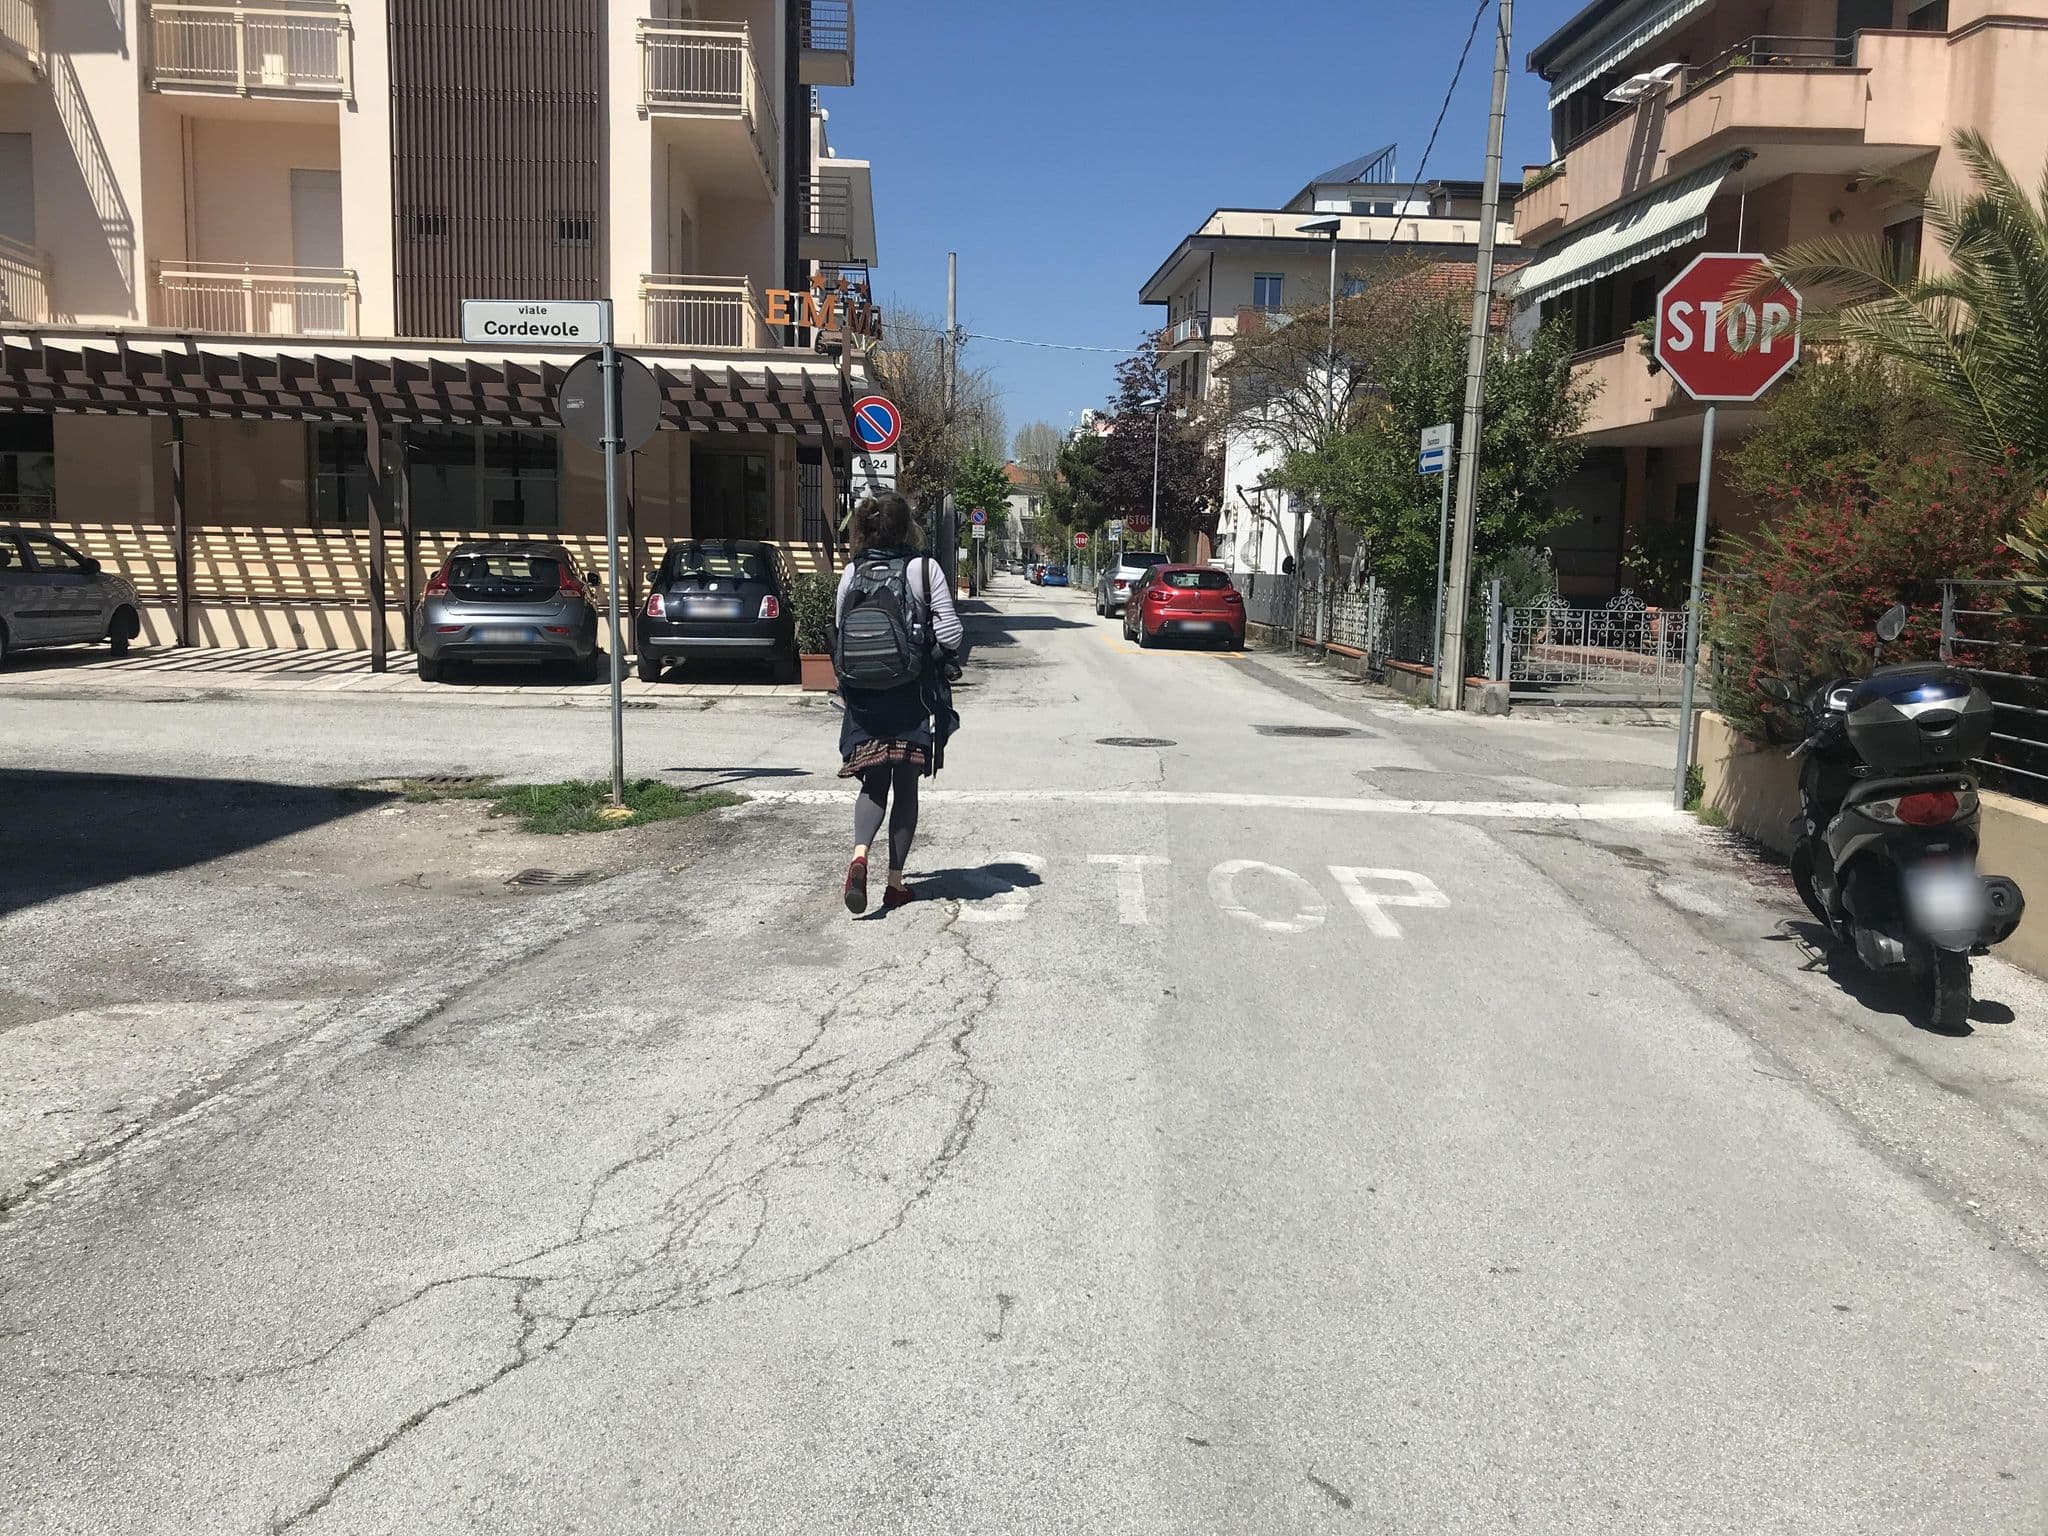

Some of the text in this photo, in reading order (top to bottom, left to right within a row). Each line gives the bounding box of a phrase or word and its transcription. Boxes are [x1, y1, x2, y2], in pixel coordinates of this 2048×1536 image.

[518, 305, 548, 315] viale
[484, 320, 579, 336] Cordevole
[1667, 300, 1790, 354] STOP
[859, 459, 888, 469] 0-24
[955, 851, 1452, 939] STOP
